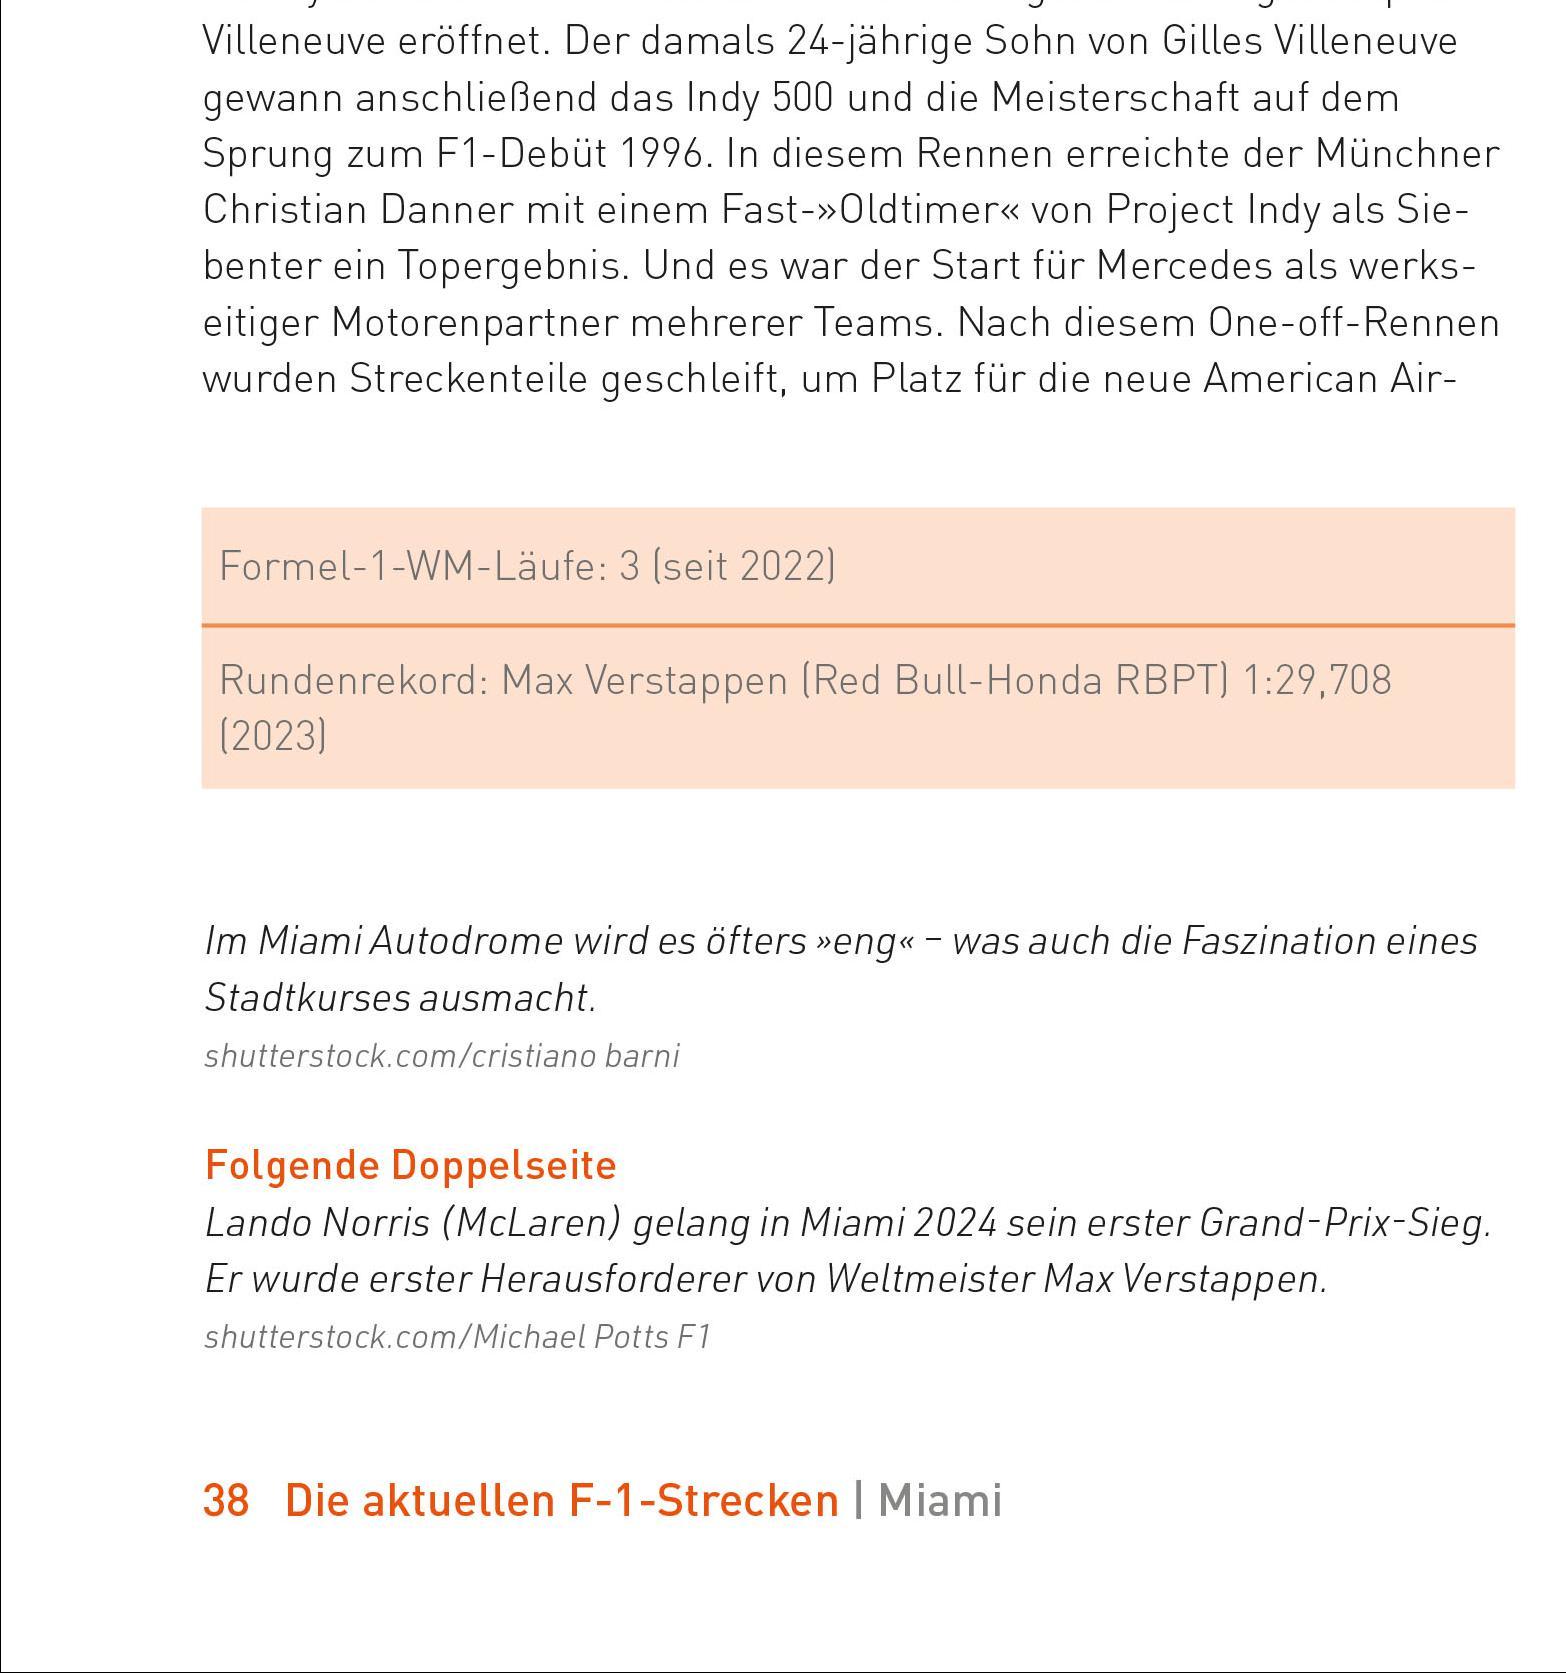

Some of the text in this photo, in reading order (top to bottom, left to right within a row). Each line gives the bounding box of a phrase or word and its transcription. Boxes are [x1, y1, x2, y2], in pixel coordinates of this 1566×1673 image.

[221, 546, 834, 585] Formel-1-WM-Läufe: 3 (seit 2022)
[221, 660, 1391, 705] Rundenrekord: Max Verstappen (Red Bull-Honda RBPT) 1:29,708
[221, 716, 325, 755] (2023)
[205, 924, 247, 955] Im
[259, 924, 363, 955] Miami
[368, 924, 563, 955] Autodrome
[574, 924, 650, 955] wird
[658, 933, 696, 955] es
[706, 924, 807, 955] öfters
[816, 933, 915, 964] »eng«
[953, 933, 1020, 955] was
[1028, 924, 1110, 955] auch
[1121, 924, 1172, 955] die
[1183, 924, 1376, 955] Faszination
[1386, 924, 1478, 955] eines
[204, 981, 595, 1012] Stadtkurses ausmacht.
[204, 1041, 681, 1069] shutterstock.com/cristiano barni
[207, 1147, 617, 1189] Folgende Doppelseite
[206, 1203, 1490, 1246] Lando Norris (McLaren) gelang in Miami 2024 sein erster Grand-Prix-Sieg.
[206, 1262, 1326, 1302] Er wurde erster Herausforderer von Weltmeister Max Verstappen.
[204, 1322, 709, 1350] shutterstock.com/Michael Potts F1
[203, 1481, 1001, 1518] 38 Die aktuellen F-1-Strecken Miami
